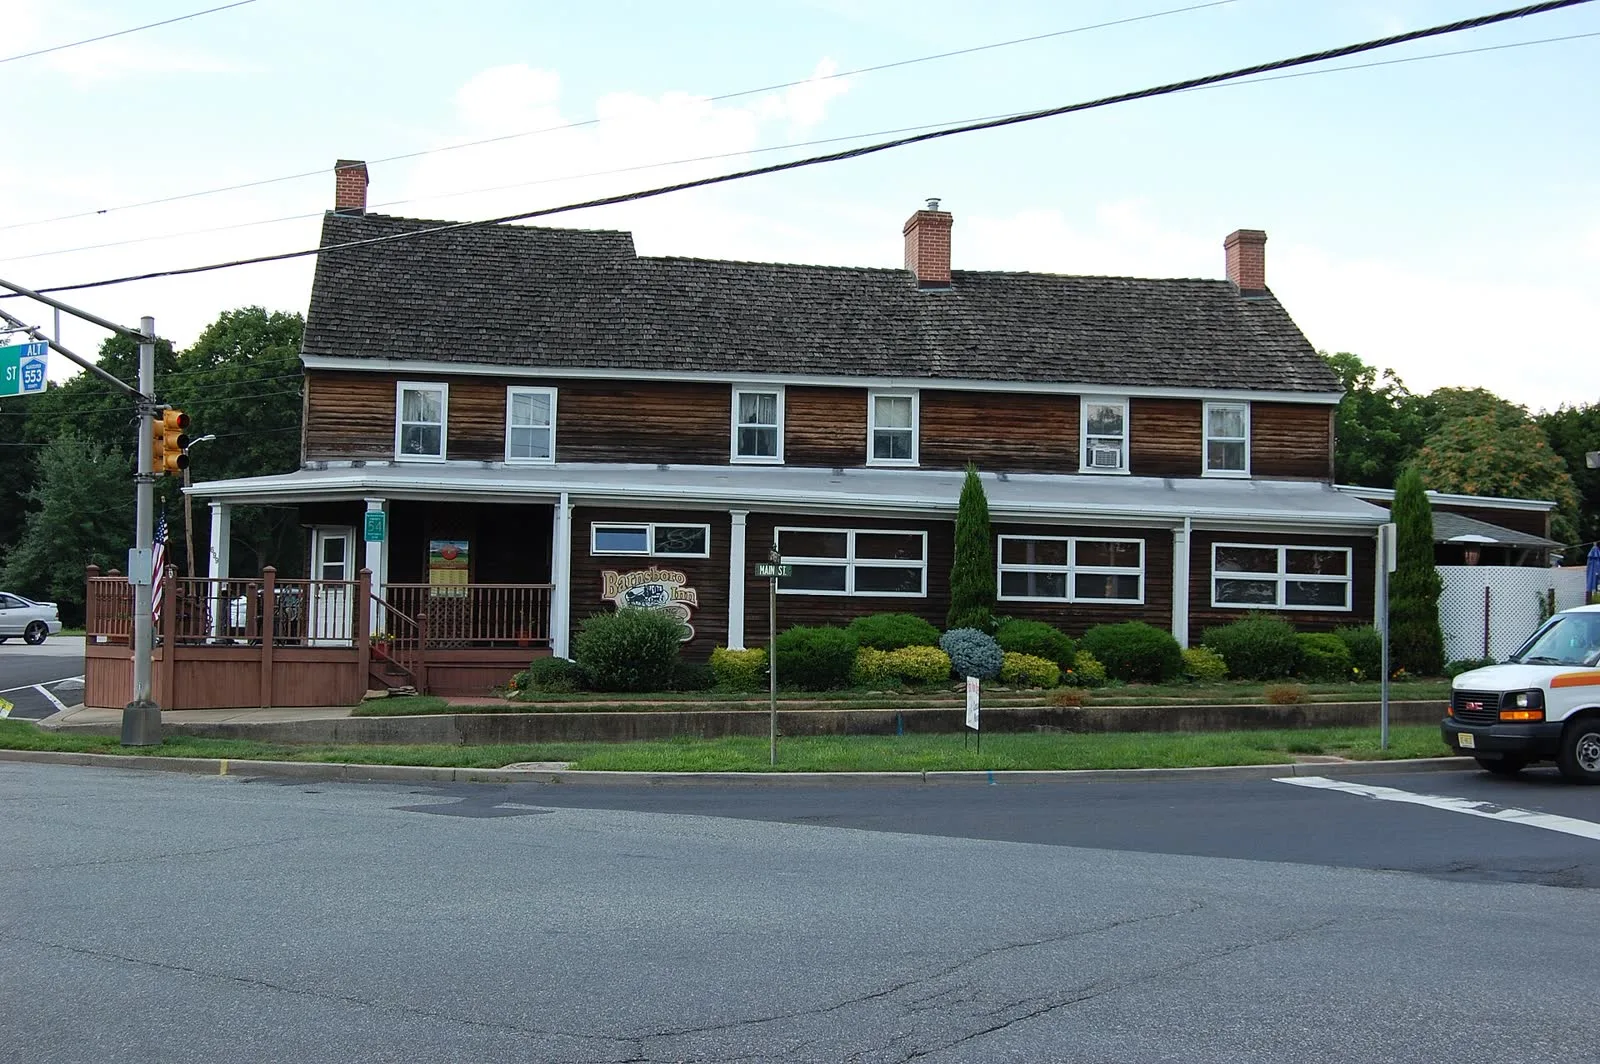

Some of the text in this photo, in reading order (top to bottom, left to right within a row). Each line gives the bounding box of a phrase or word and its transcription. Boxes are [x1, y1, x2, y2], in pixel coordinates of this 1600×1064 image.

[27, 344, 42, 357] ALT
[6, 366, 17, 381] ST
[25, 369, 42, 384] 553
[759, 565, 775, 576] MAIN
[603, 566, 686, 599] Barnsboro
[670, 586, 696, 603] Inn
